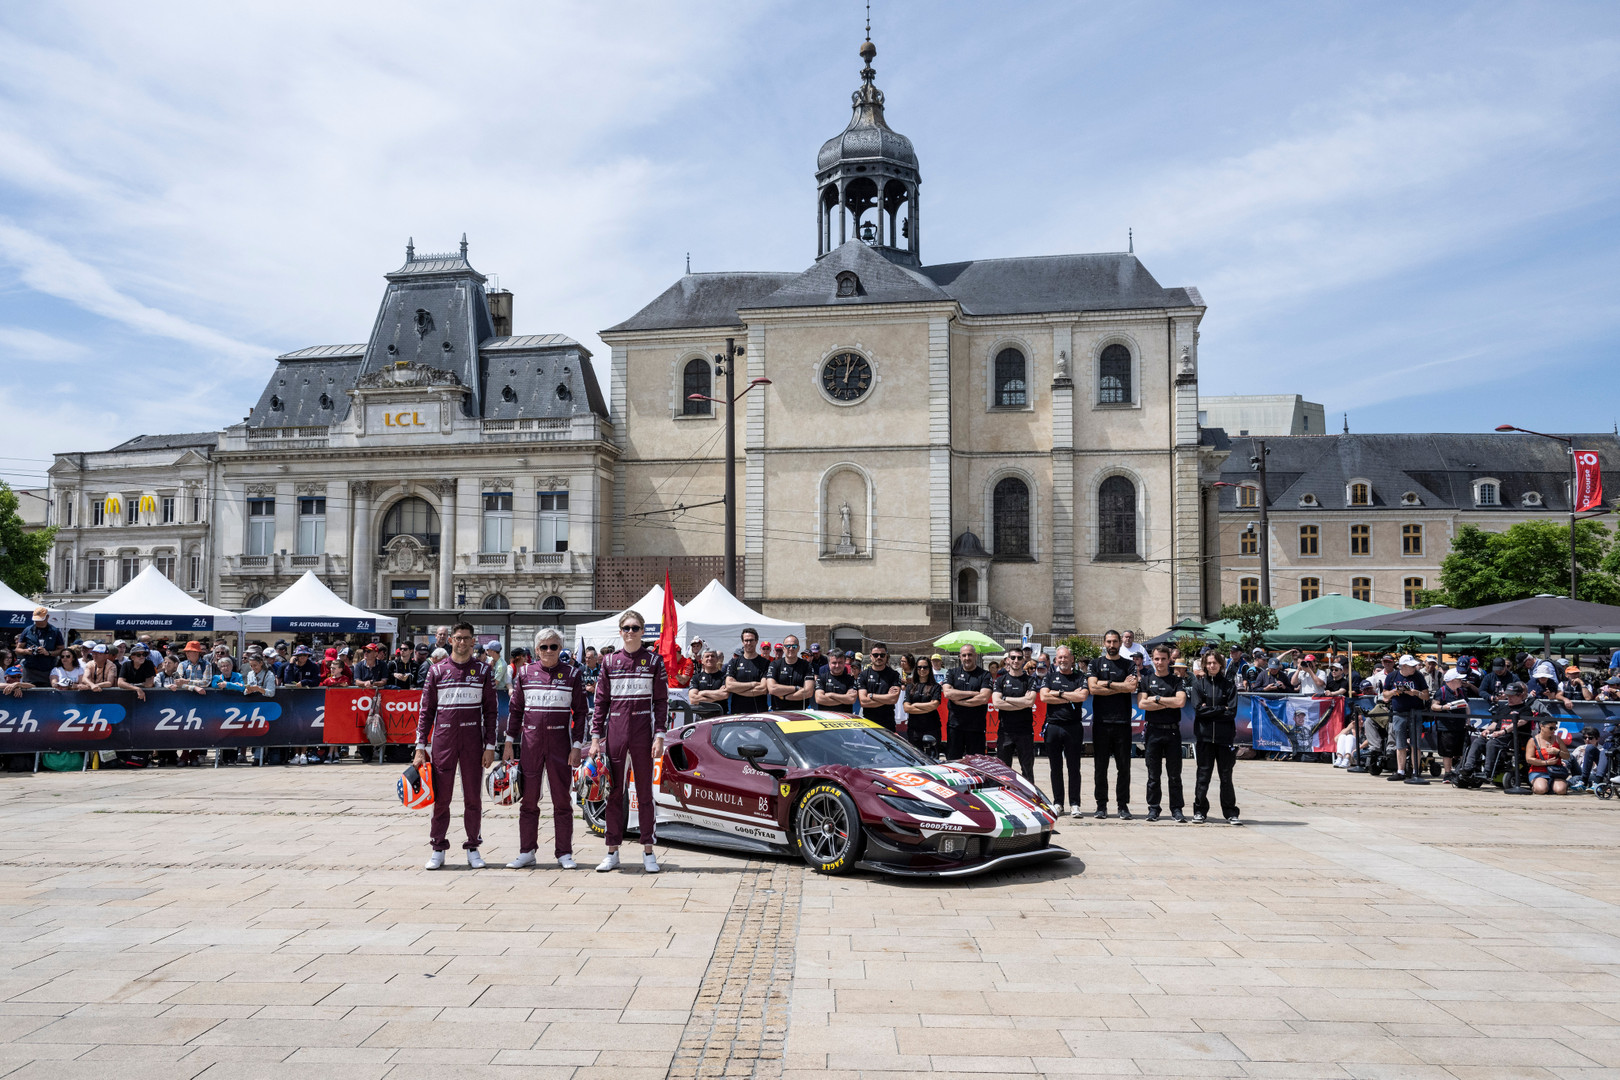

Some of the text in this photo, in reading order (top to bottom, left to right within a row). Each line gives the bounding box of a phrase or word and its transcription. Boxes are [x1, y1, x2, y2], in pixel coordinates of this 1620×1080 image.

[385, 412, 425, 426] LCL
[385, 701, 418, 712] cou
[57, 709, 108, 732] 24h
[154, 708, 203, 731] 24h
[220, 707, 266, 730] 24h
[389, 713, 418, 728] MA
[695, 788, 744, 807] FORMULA
[734, 825, 776, 840] GOODYEAR
[920, 822, 963, 832] GOODYEAR
[822, 857, 844, 871] EAGLE
